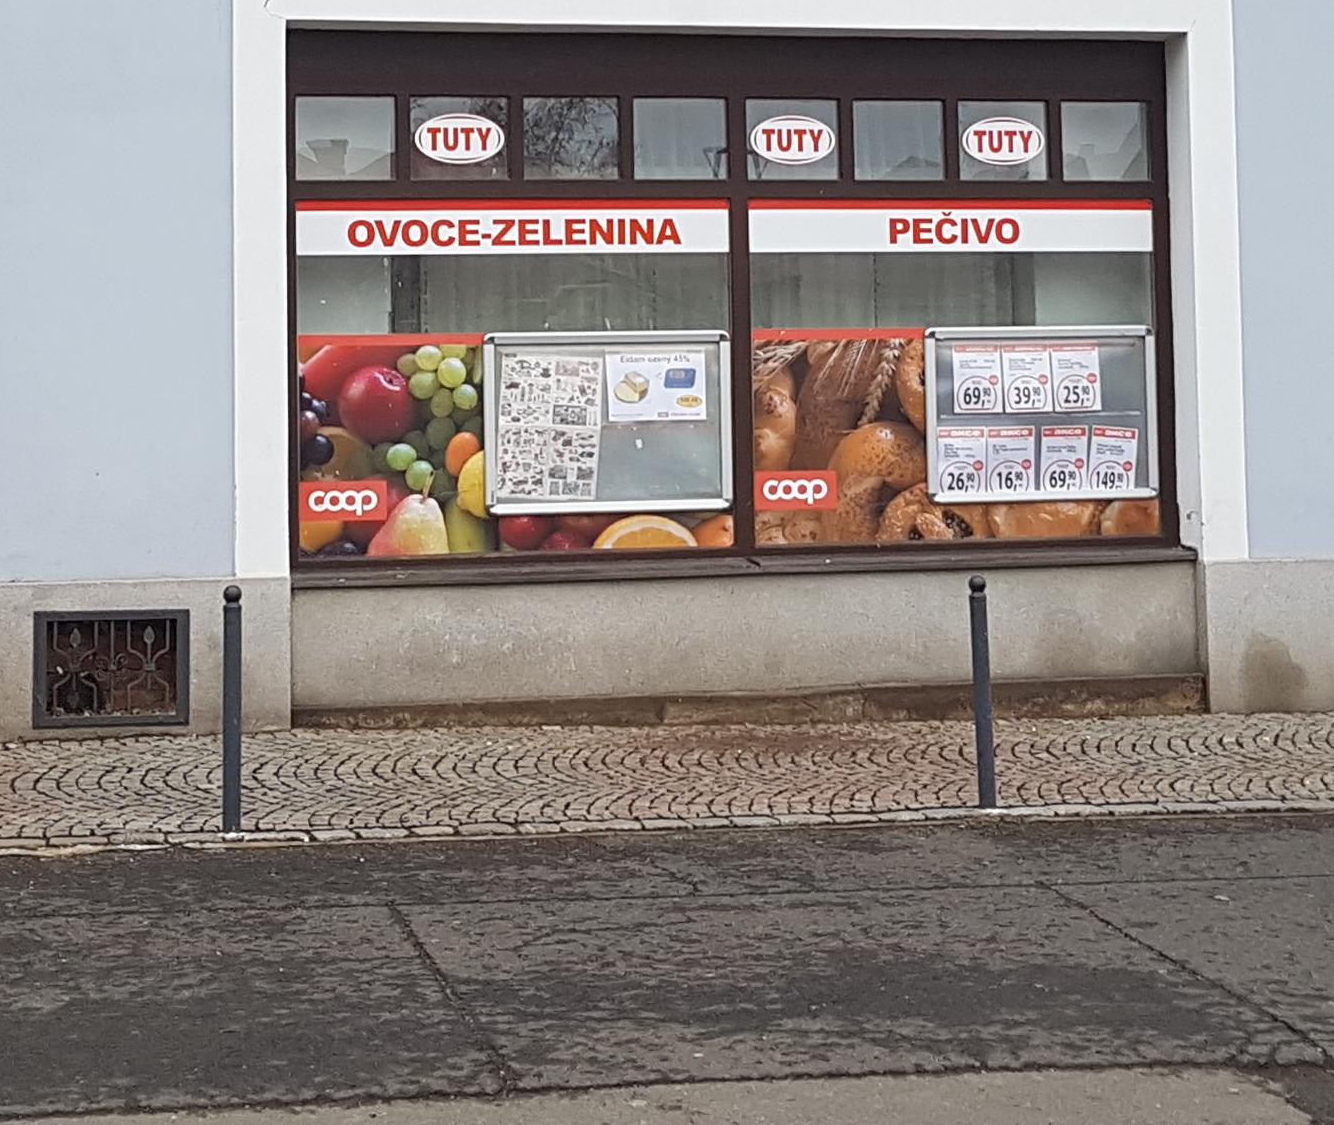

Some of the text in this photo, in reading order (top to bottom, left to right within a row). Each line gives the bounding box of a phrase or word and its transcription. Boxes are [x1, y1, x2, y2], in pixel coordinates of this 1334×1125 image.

[427, 127, 492, 151] TUTY
[762, 129, 823, 152] TUTY
[973, 130, 1033, 153] TUTY
[347, 218, 681, 248] OVOCE-ZELENINA
[889, 212, 1020, 244] PEČIVO
[308, 490, 378, 516] coop
[762, 478, 828, 504] coop
